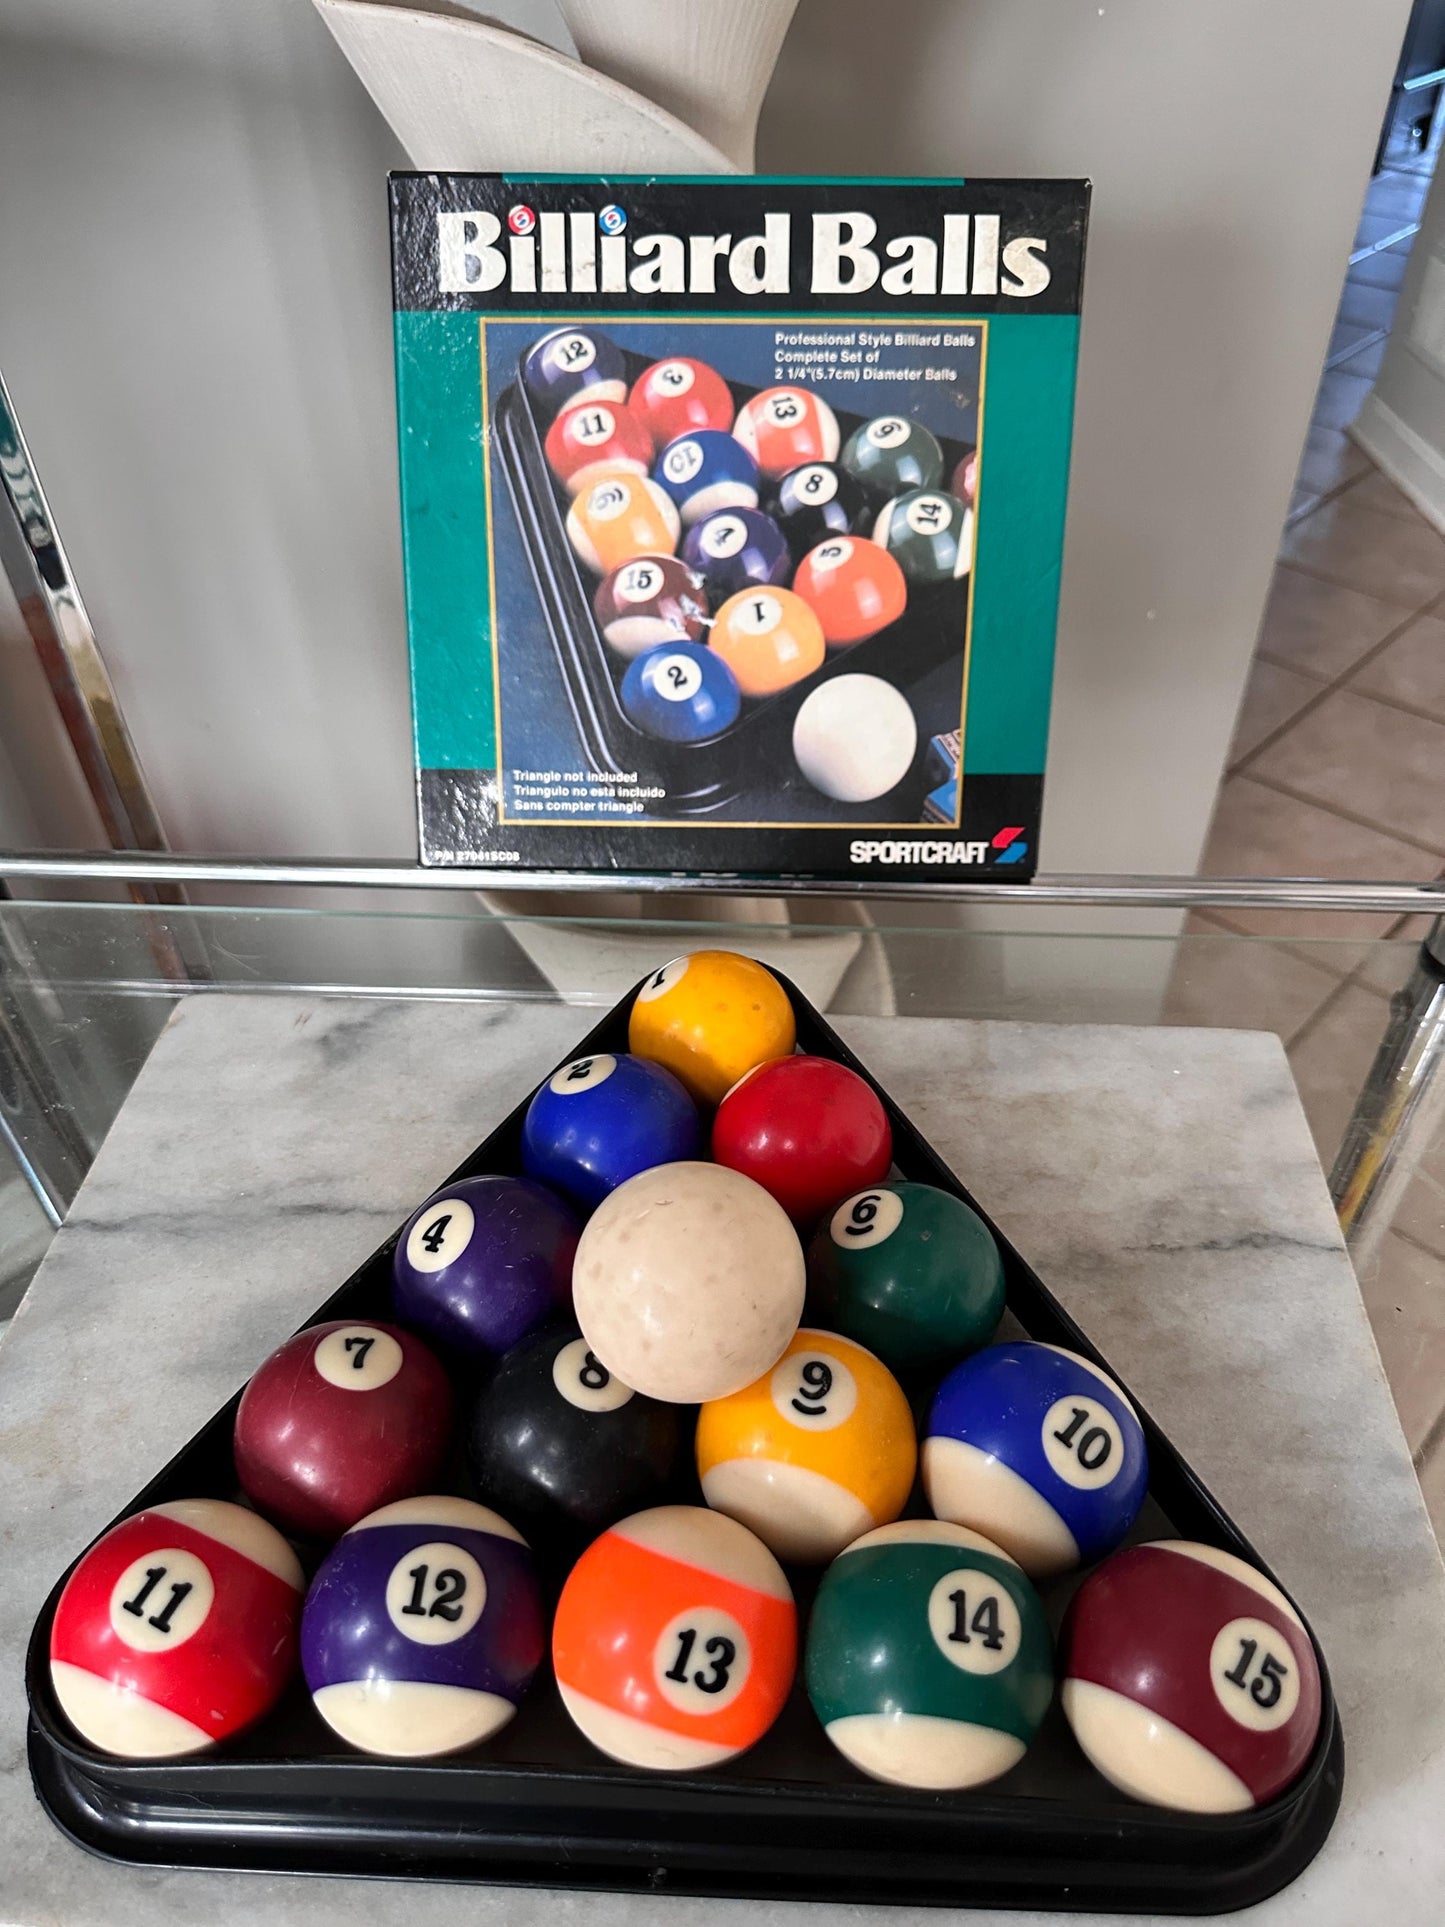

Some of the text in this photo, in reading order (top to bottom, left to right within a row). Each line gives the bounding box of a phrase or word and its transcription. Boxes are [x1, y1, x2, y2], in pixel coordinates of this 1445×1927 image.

[436, 204, 1052, 297] Billiard Balls
[775, 332, 976, 348] Professional Style Billiard Balls
[560, 340, 588, 365] 12
[775, 350, 880, 365] Complete Set of
[663, 368, 683, 386] 3
[775, 367, 783, 380] 2
[863, 368, 922, 381] Diameter
[925, 368, 957, 381] Balls
[772, 396, 797, 420] 13
[579, 414, 608, 438] 11
[805, 474, 823, 493] 8
[917, 503, 941, 526] 14
[714, 527, 735, 547] 4
[624, 569, 654, 590] 15
[752, 602, 766, 623] 1
[668, 666, 688, 689] 2
[513, 769, 638, 784] Triangle not included
[513, 784, 570, 799] Triangulo
[572, 787, 588, 797] no
[618, 786, 666, 799] incluido
[514, 800, 645, 814] Sans compter triangle
[850, 840, 990, 864] SPORTCRAFT
[567, 1059, 594, 1081] 2
[845, 1195, 882, 1236] 6
[421, 1213, 453, 1254] 4
[344, 1336, 376, 1369] 7
[579, 1350, 610, 1390] 8
[792, 1360, 833, 1416] 9
[1052, 1407, 1113, 1471] 10
[122, 1565, 194, 1634] 11
[400, 1563, 468, 1623] 12
[947, 1588, 1006, 1651] 14
[664, 1628, 736, 1694] 13
[1223, 1637, 1289, 1709] 15
